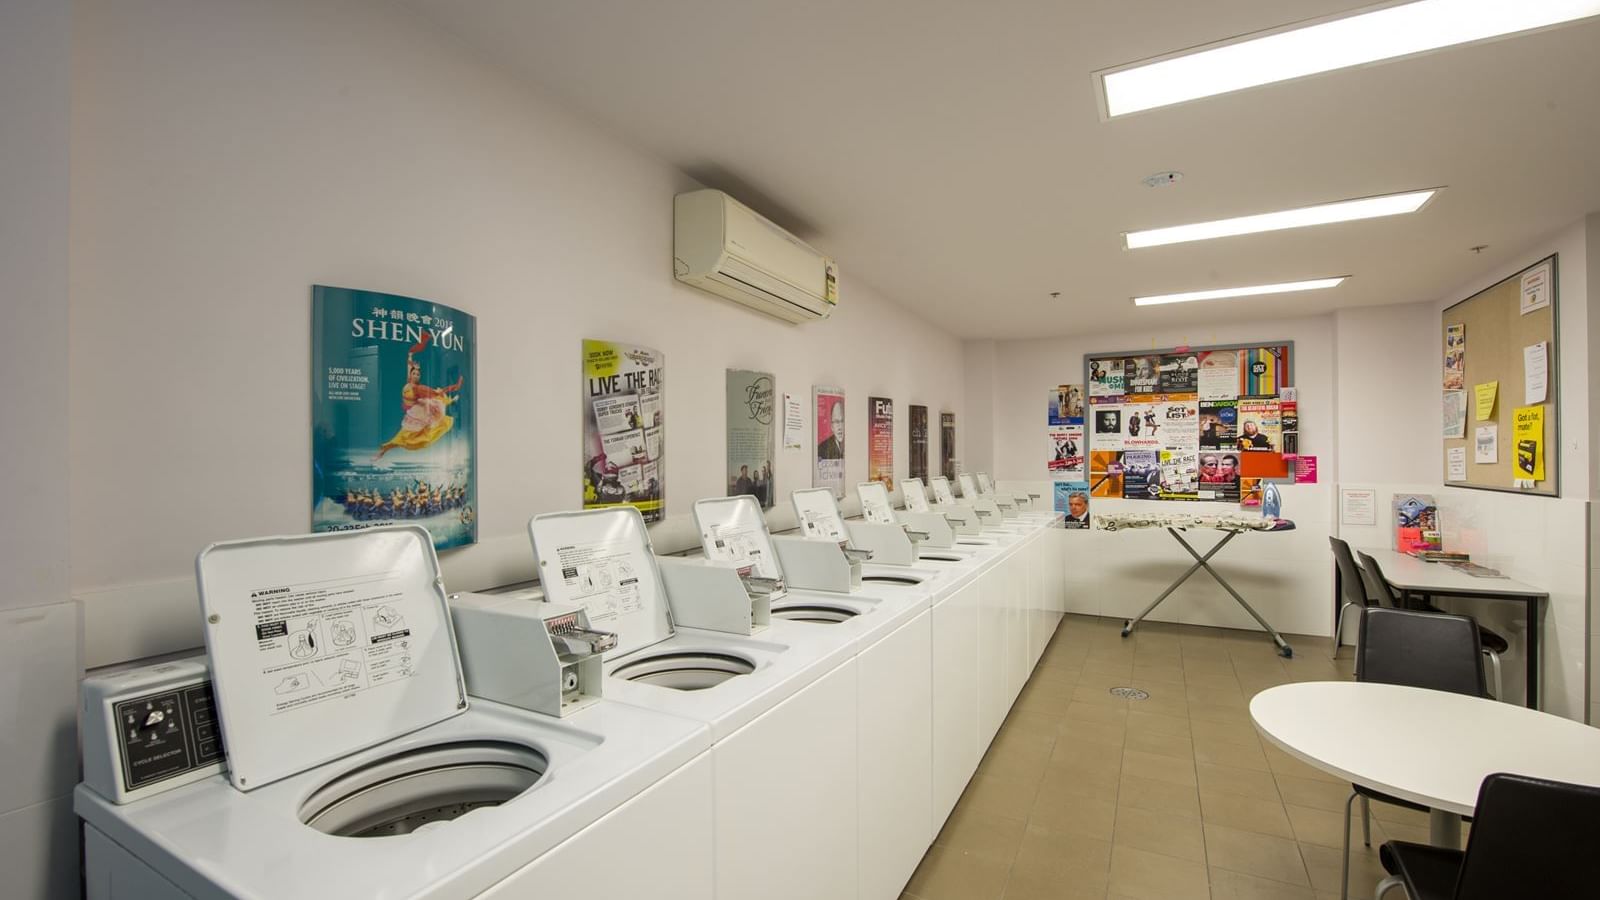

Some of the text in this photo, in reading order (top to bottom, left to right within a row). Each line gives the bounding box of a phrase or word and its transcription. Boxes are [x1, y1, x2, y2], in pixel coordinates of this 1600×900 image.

[351, 318, 464, 352] SHEN YUN
[589, 374, 621, 397] LIVE
[624, 370, 647, 390] THE
[258, 587, 290, 596] WARNING
